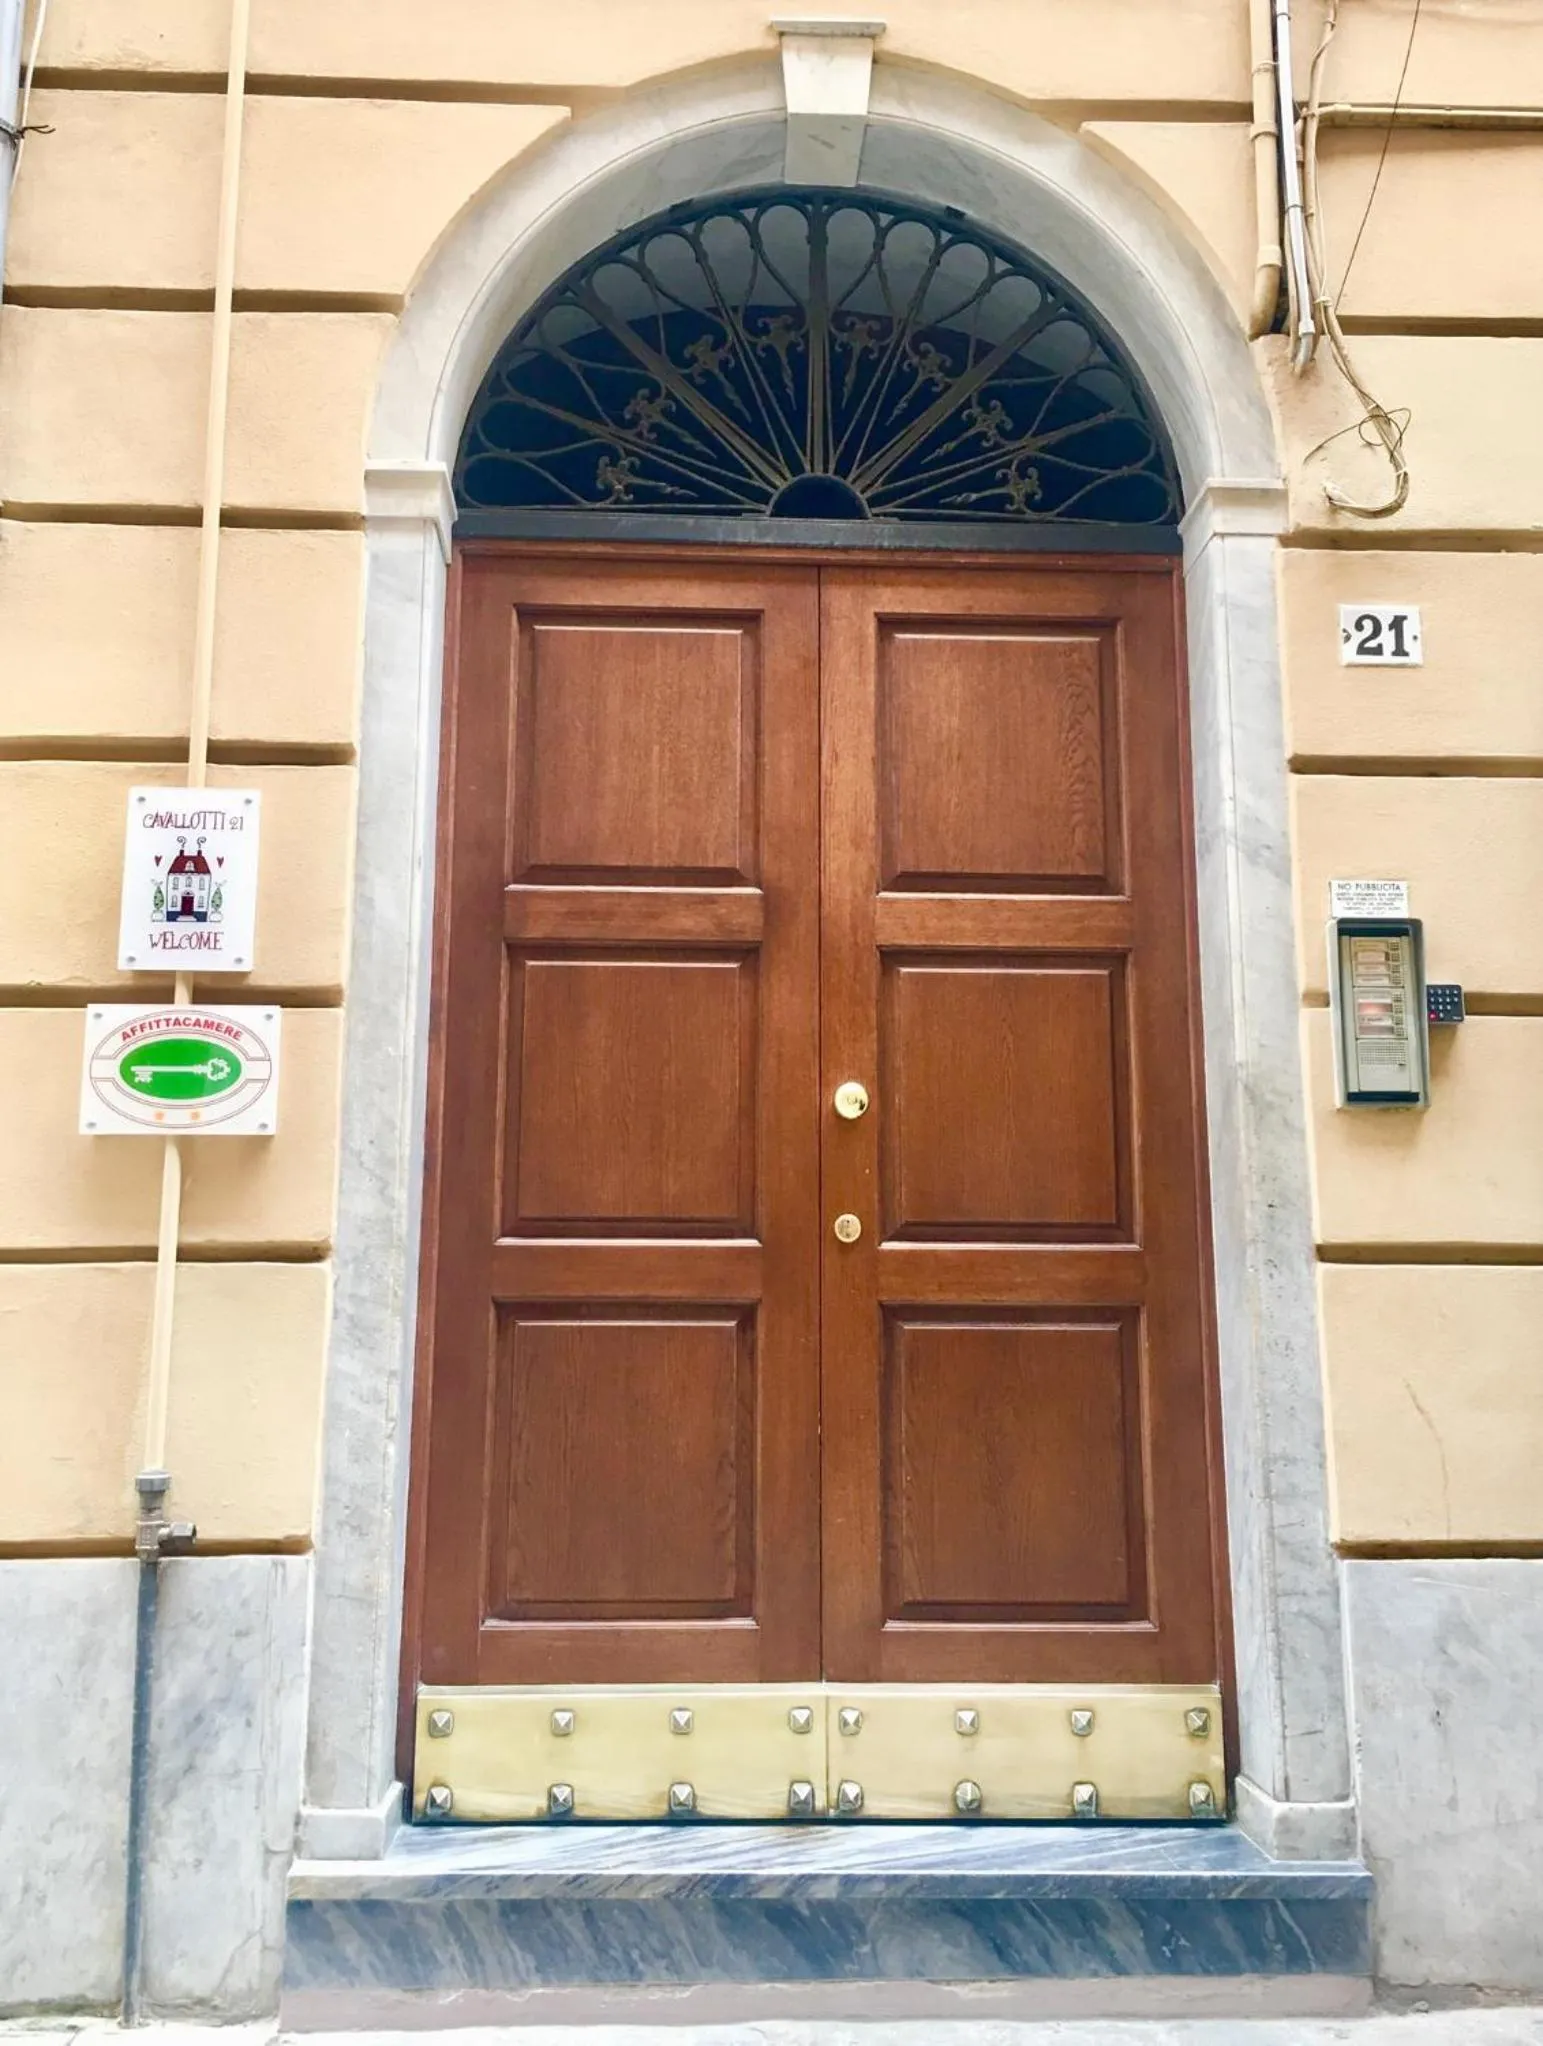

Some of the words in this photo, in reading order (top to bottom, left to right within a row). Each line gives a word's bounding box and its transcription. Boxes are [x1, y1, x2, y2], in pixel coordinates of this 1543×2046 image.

[1354, 613, 1410, 657] 21
[142, 810, 226, 830] CAVALLOTTI
[229, 816, 244, 831] 21
[149, 931, 224, 950] WELCOME
[121, 1017, 243, 1041] AFFITTACAMERE
